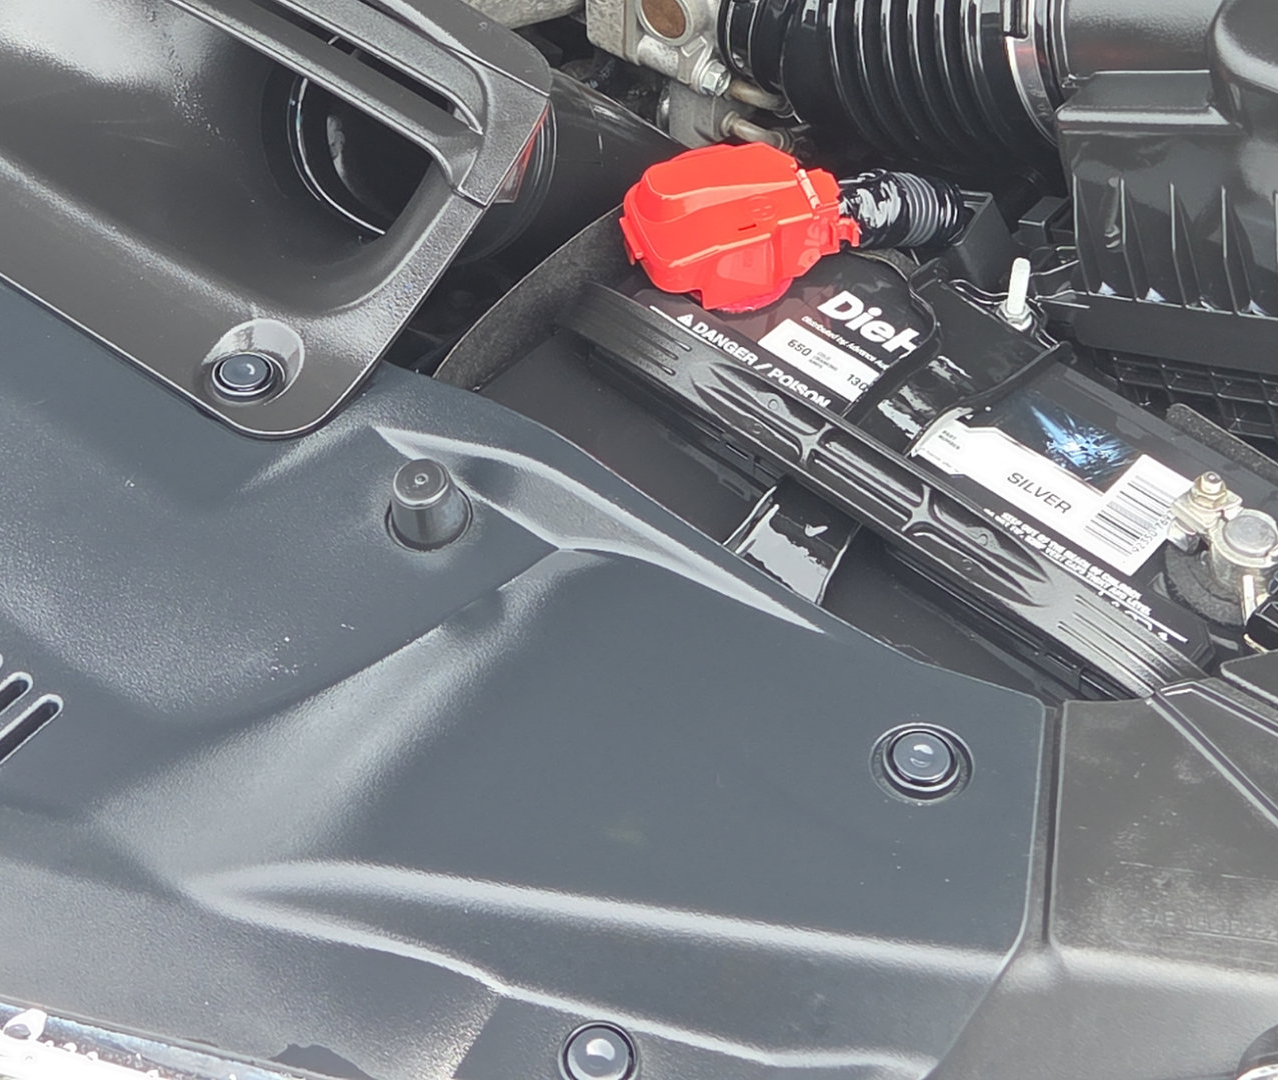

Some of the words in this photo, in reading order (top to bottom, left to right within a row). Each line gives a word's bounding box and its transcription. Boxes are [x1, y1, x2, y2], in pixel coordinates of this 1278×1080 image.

[692, 321, 758, 366] DANGER
[767, 369, 832, 409] POISON
[787, 339, 812, 357] 650
[1007, 472, 1072, 514] SILVER
